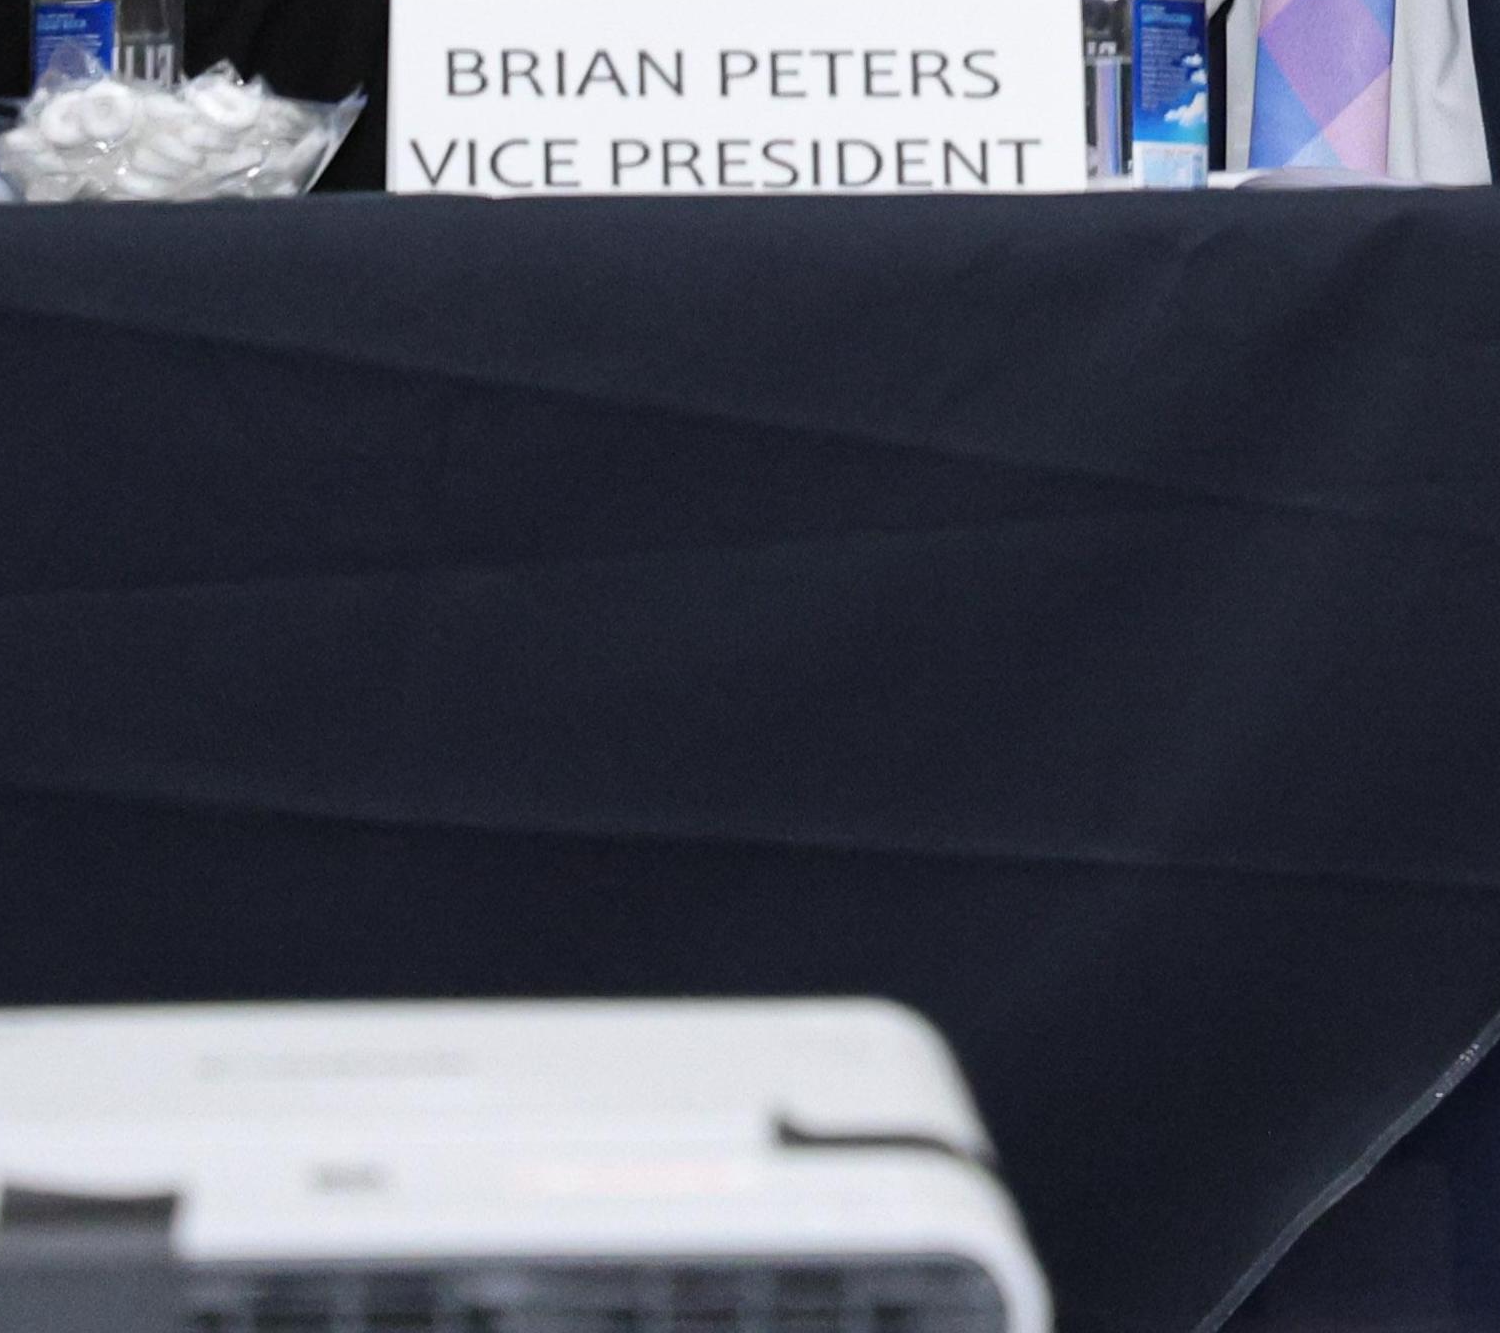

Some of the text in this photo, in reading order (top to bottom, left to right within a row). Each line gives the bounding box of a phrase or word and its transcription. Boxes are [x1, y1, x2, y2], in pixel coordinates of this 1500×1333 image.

[446, 49, 1002, 99] BRIAN PETERS
[409, 139, 1042, 189] VICE PRESIDENT
